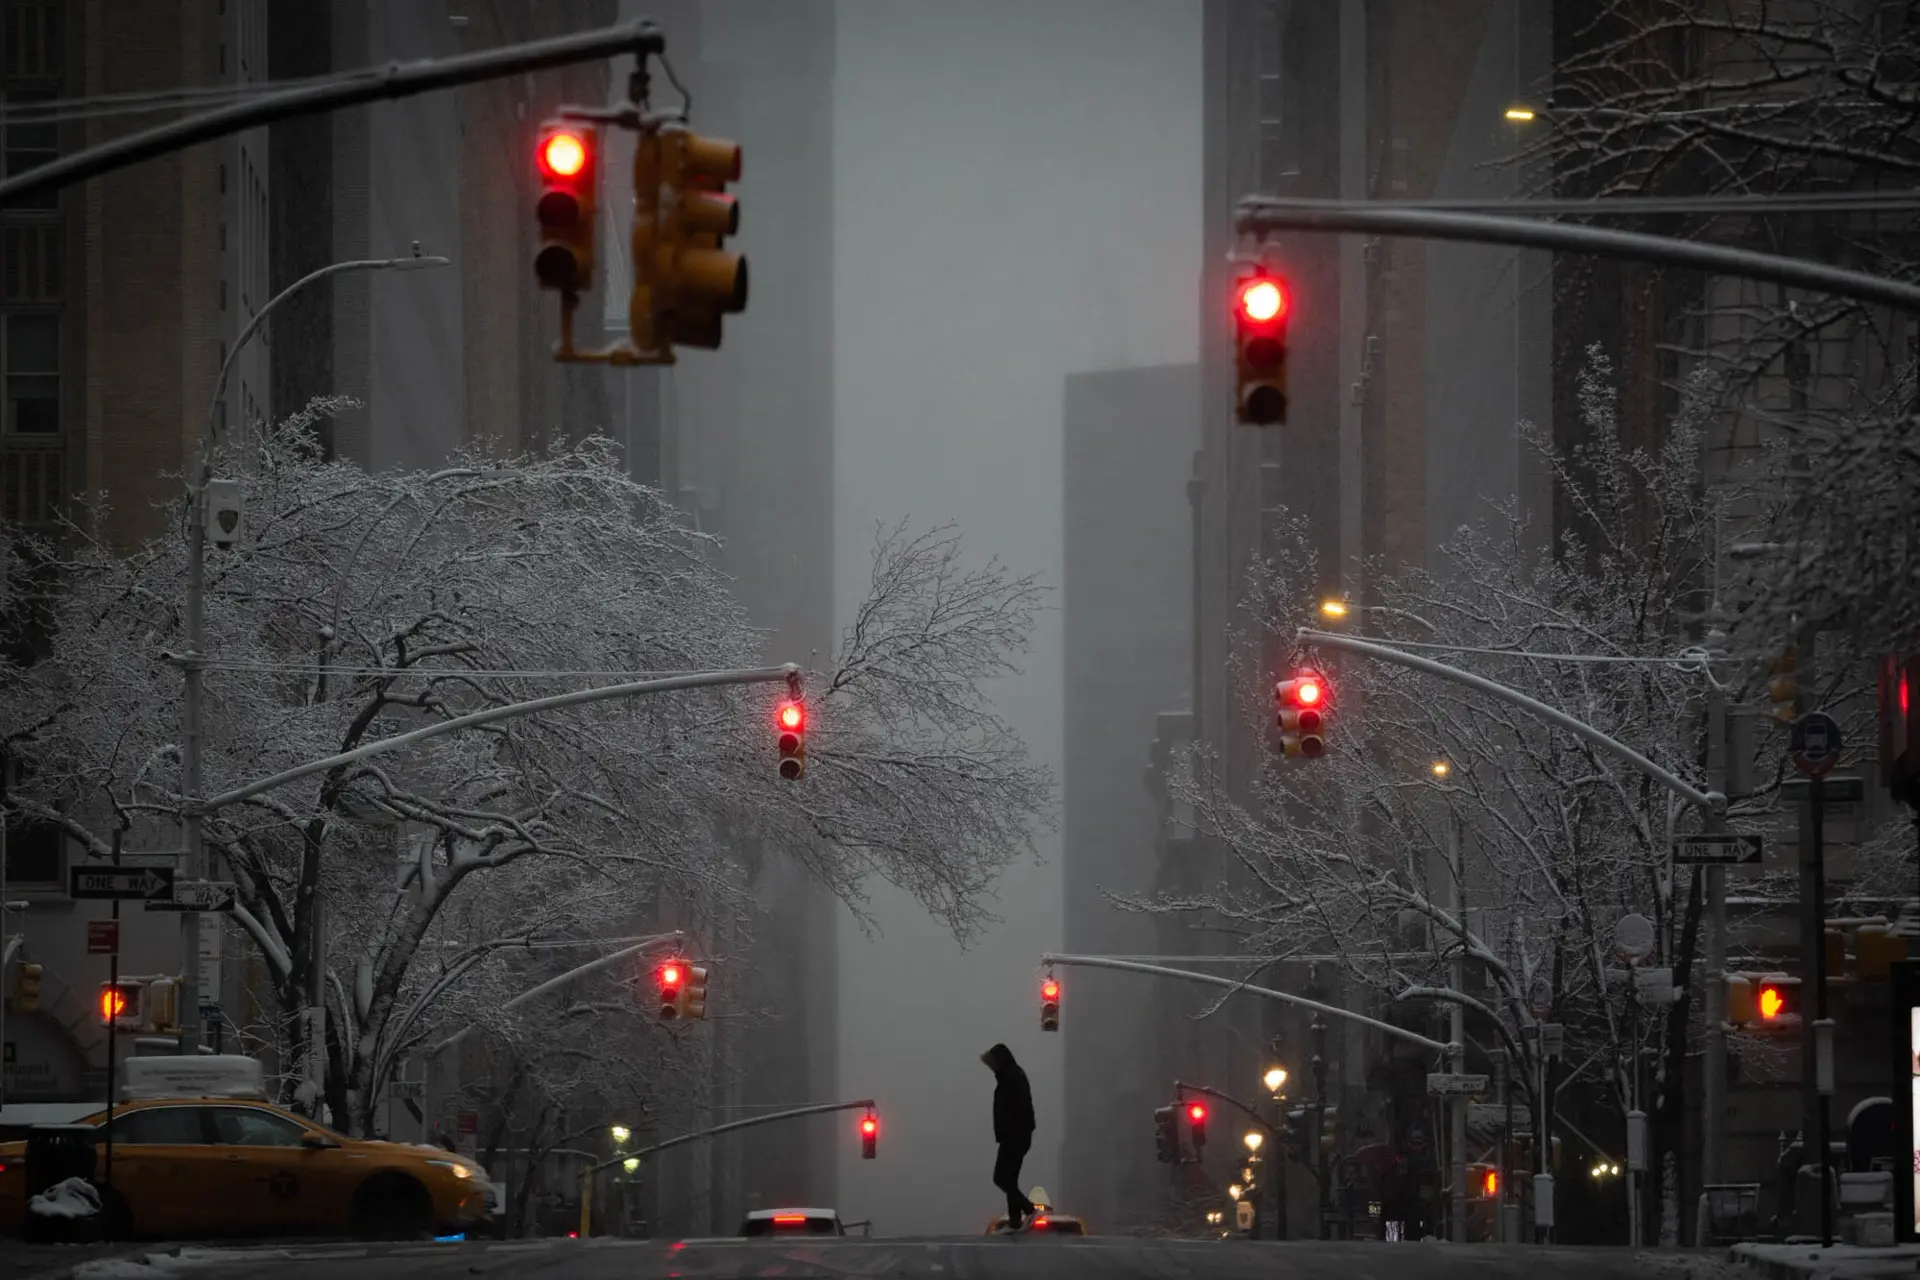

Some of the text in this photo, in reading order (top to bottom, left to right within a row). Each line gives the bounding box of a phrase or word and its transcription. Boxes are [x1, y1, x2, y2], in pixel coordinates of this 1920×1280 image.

[1685, 845, 1748, 855] ONE WAY
[86, 876, 157, 890] ONE WAY
